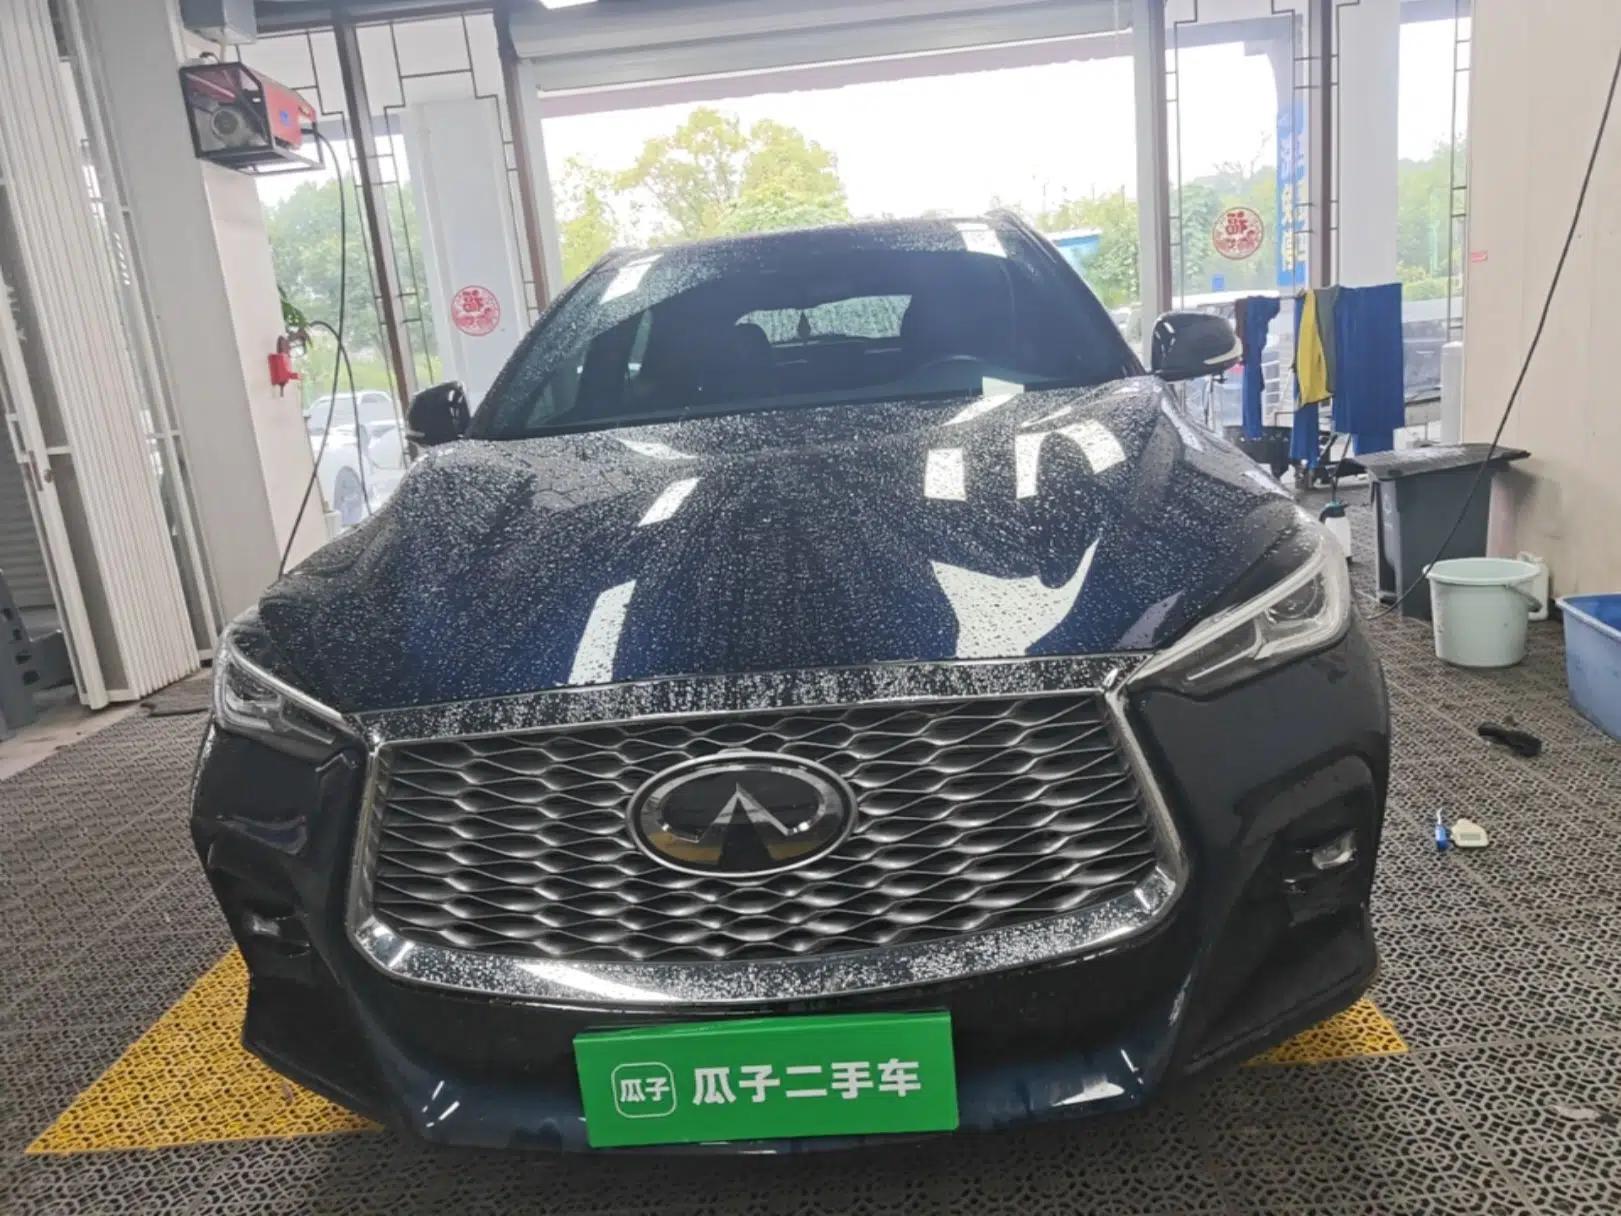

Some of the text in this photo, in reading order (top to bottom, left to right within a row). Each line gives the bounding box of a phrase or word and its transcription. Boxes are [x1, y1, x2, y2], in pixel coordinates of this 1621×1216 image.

[620, 1077, 670, 1103] 瓜子
[693, 1058, 921, 1105] 瓜子二手车
